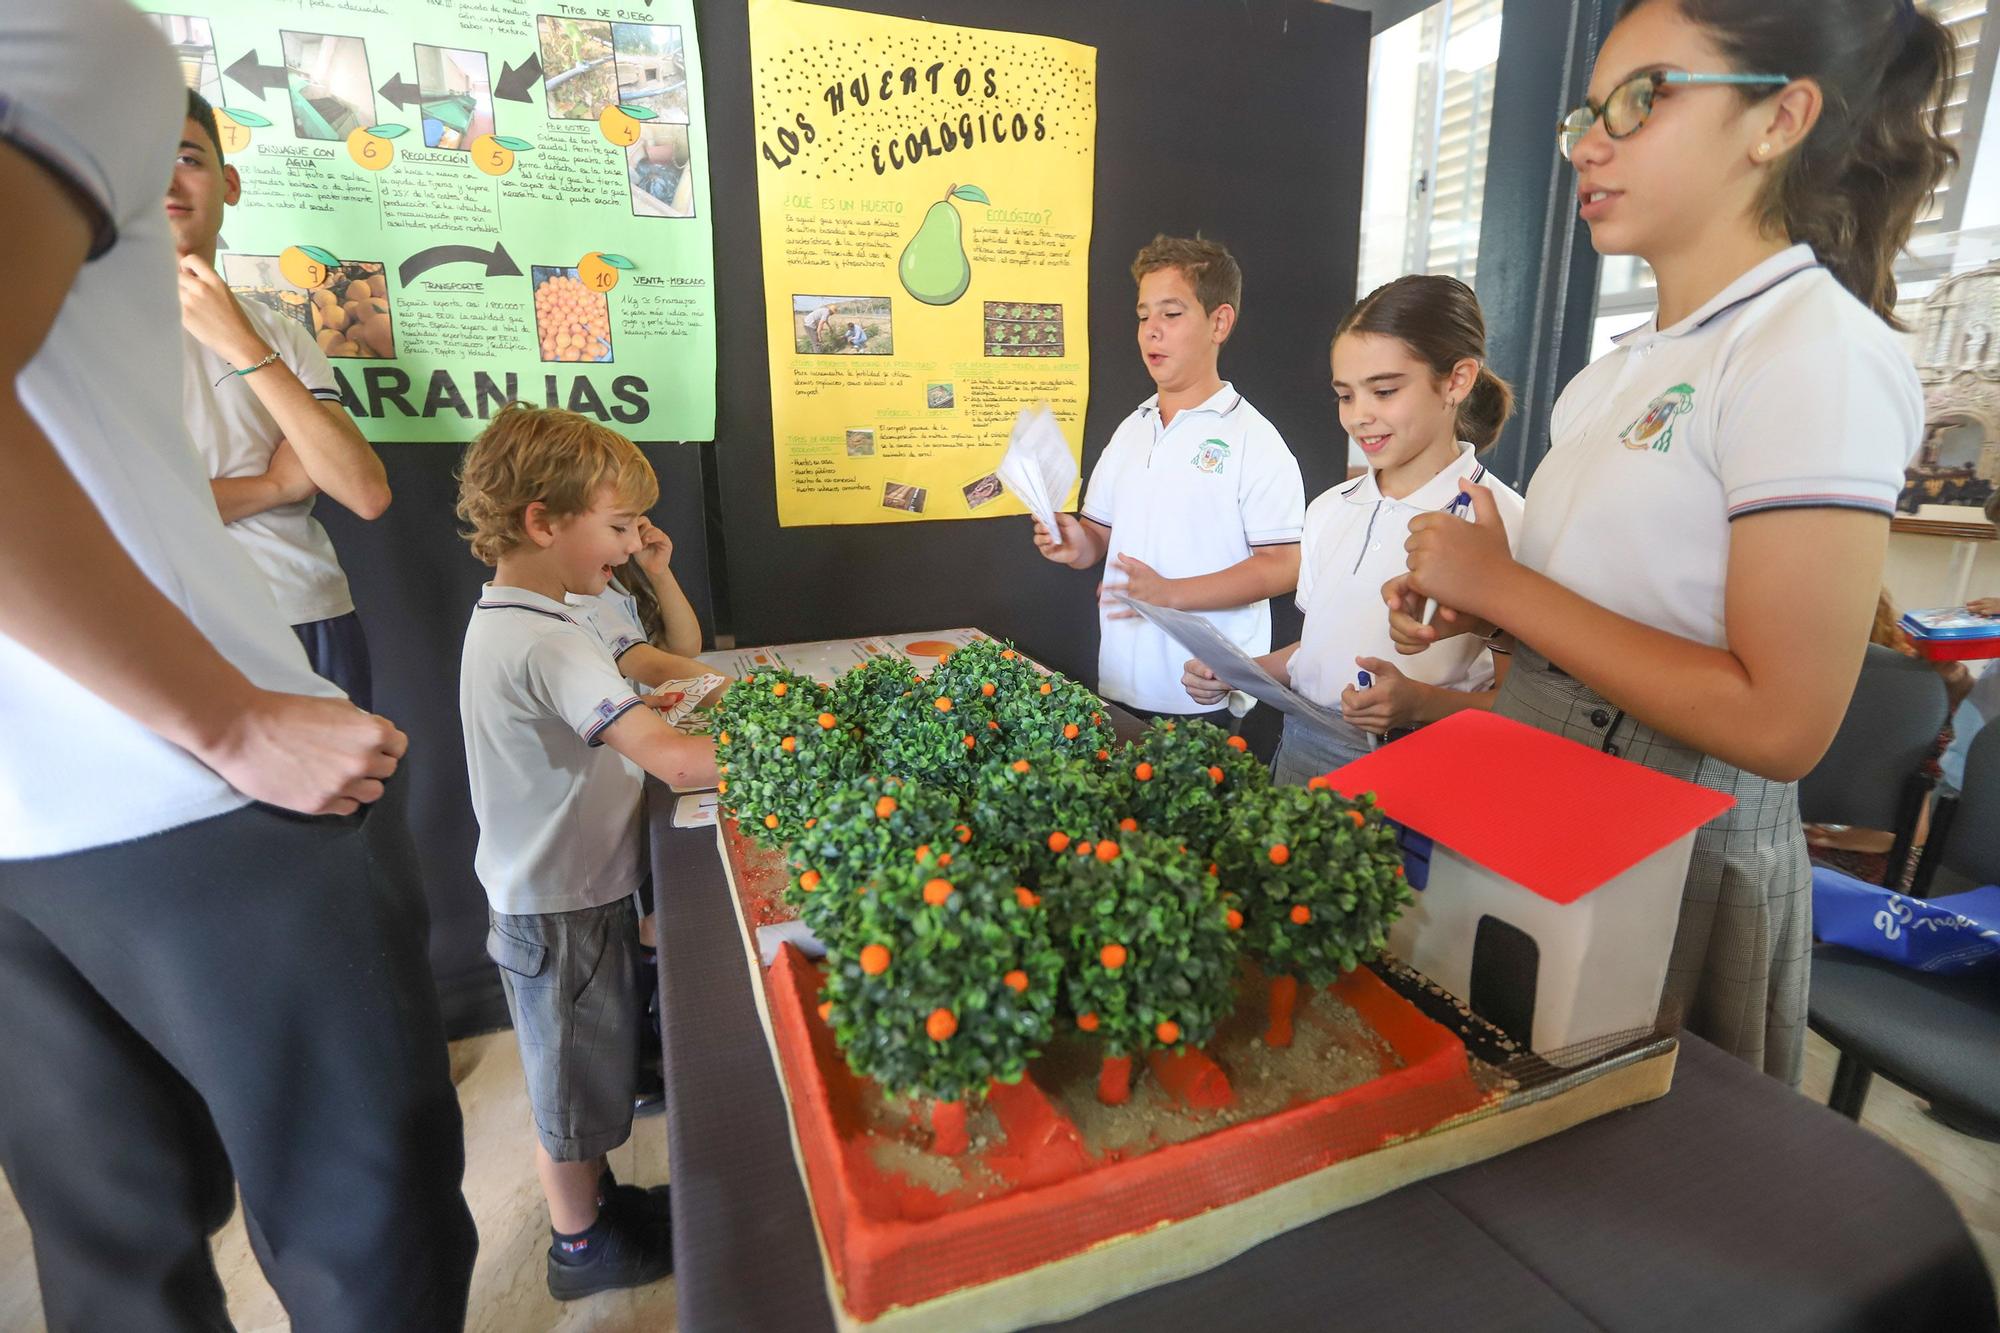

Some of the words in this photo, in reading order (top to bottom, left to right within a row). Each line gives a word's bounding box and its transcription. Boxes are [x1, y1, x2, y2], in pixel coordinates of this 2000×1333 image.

[597, 8, 610, 18] DE
[618, 9, 655, 22] RIEGO
[762, 112, 816, 171] LOS
[823, 61, 997, 117] HUERTOS
[223, 126, 237, 146] 7
[624, 126, 633, 142] 4
[363, 141, 377, 158] 6
[871, 111, 1046, 176] ECOLÓGICOS
[313, 148, 335, 158] CON
[401, 149, 468, 165] RECOLECCIÓN
[491, 151, 504, 167] 5
[285, 158, 317, 169] AGUA
[822, 198, 836, 210] ES
[840, 199, 855, 212] UN
[861, 199, 904, 214] HUERTO
[307, 265, 318, 283] 9
[595, 272, 613, 288] 10
[419, 280, 485, 291] TRANSPORTE
